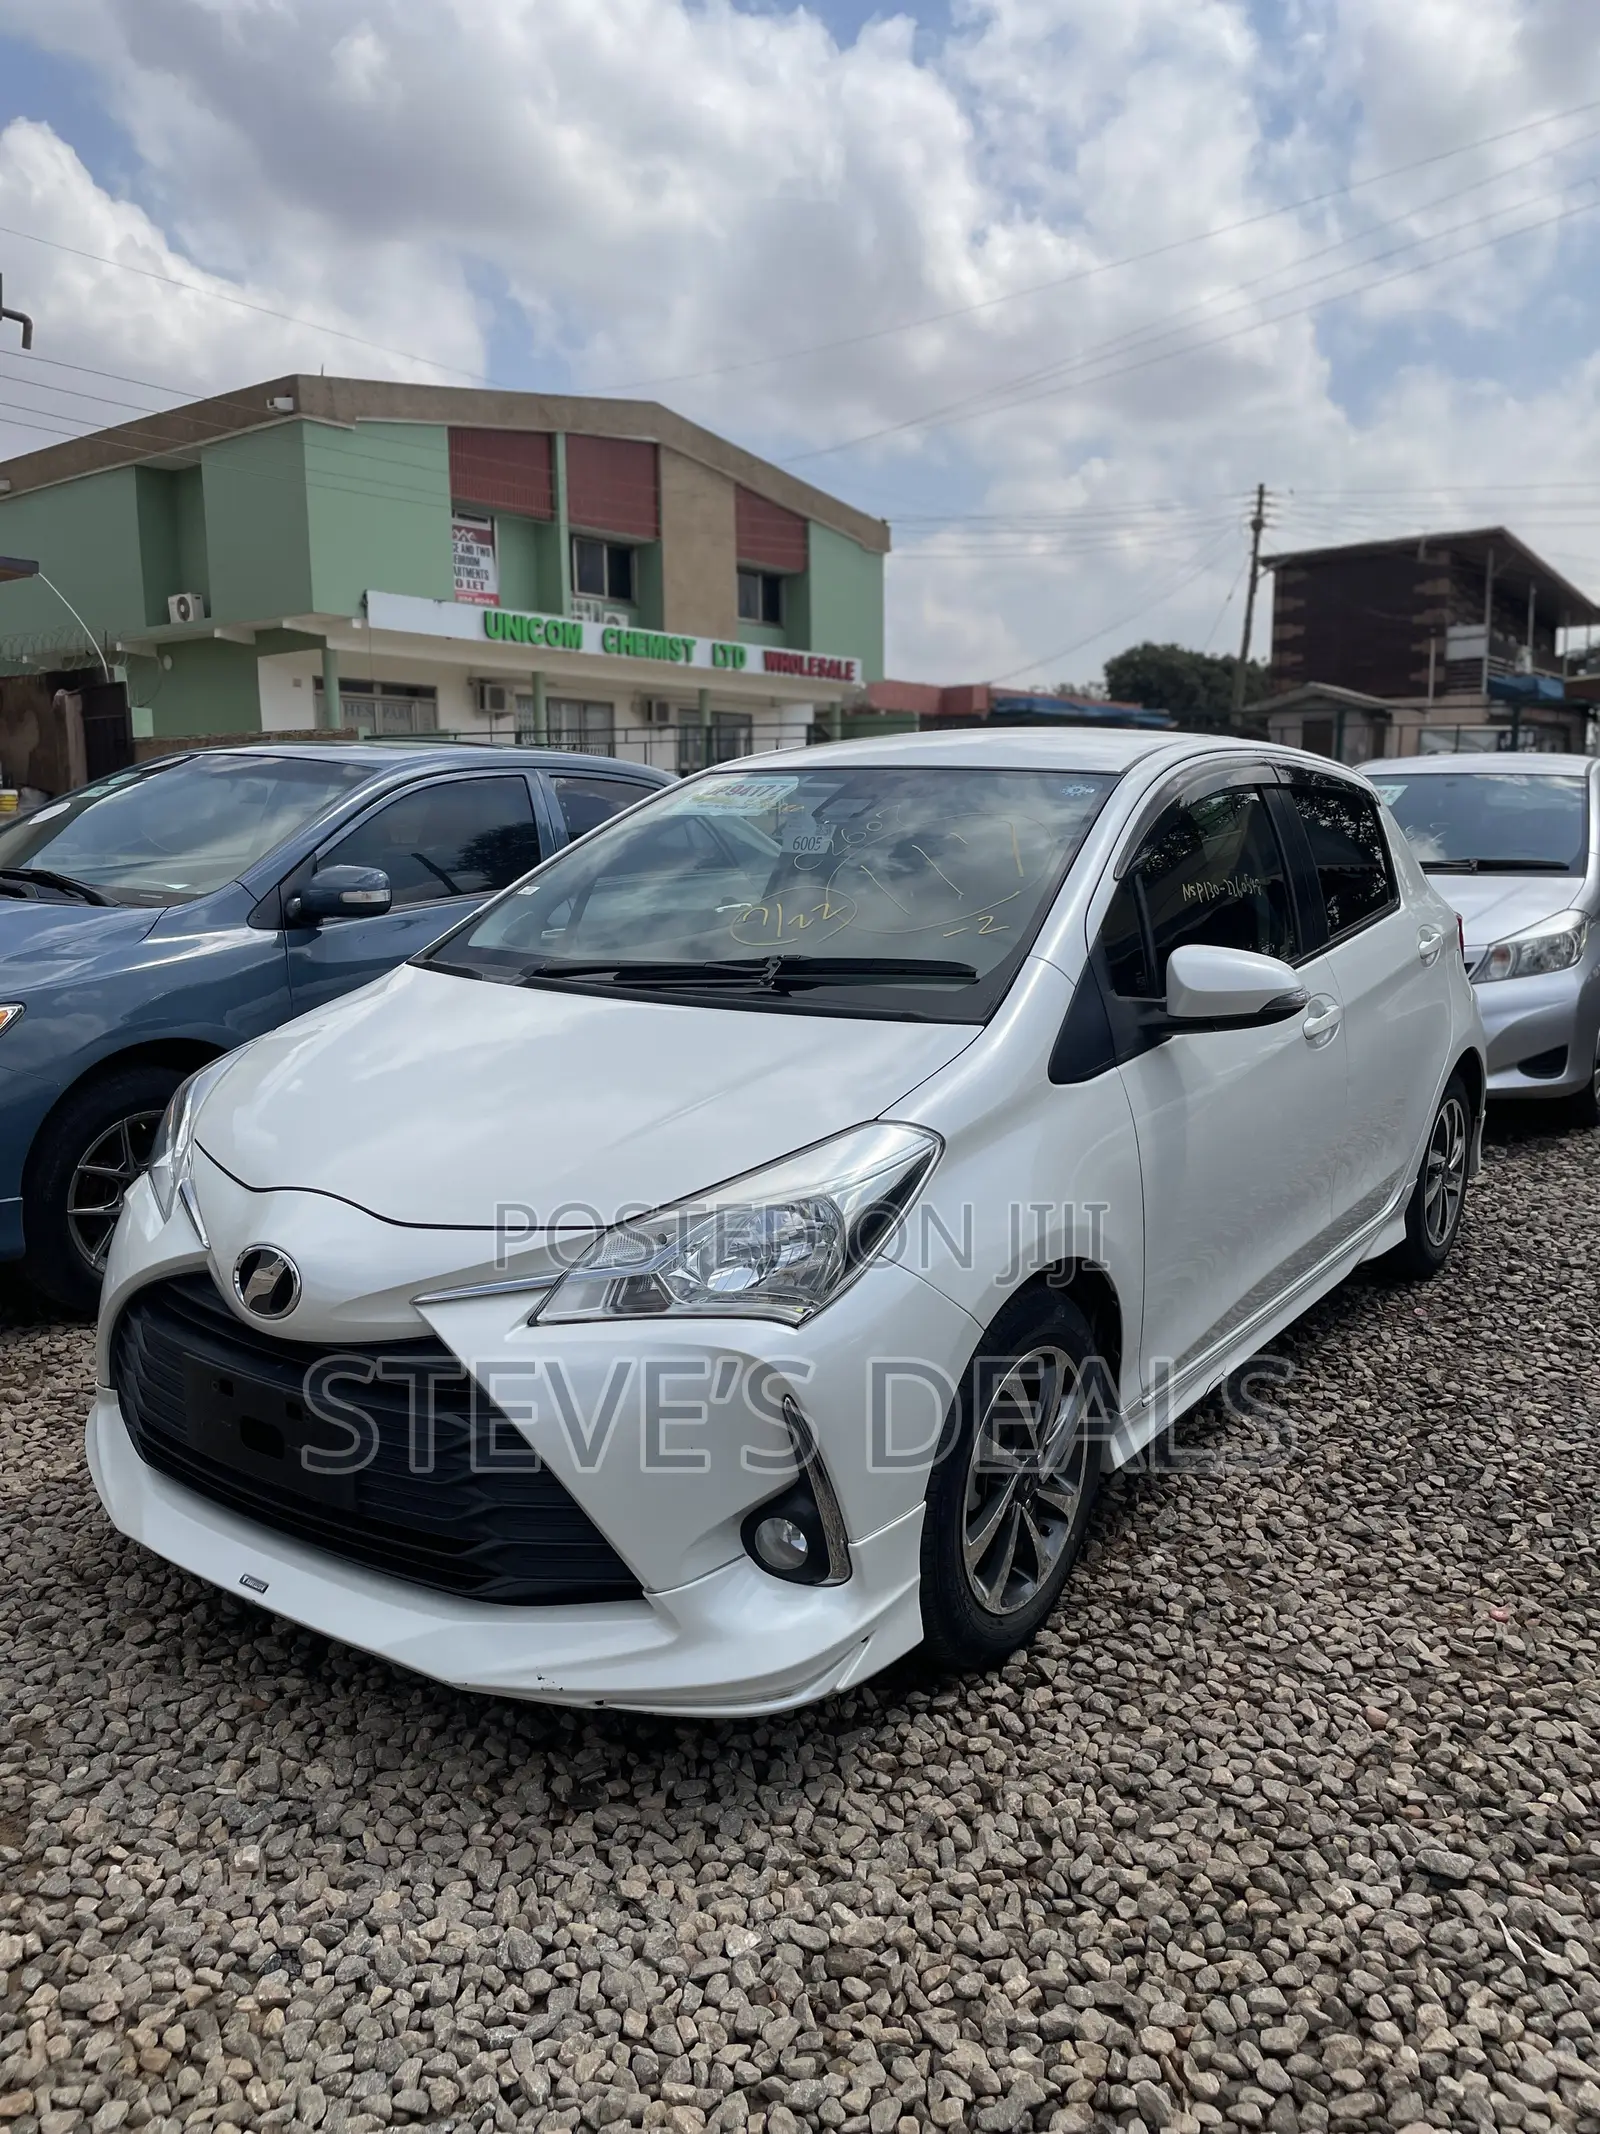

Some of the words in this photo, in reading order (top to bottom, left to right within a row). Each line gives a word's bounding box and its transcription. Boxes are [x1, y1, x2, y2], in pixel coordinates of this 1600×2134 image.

[461, 544, 475, 555] AND
[476, 545, 491, 558] TWO
[466, 579, 485, 591] LET
[483, 610, 583, 650] UNICOM
[601, 627, 696, 662] CHEMIST
[712, 642, 746, 669] LTD
[763, 650, 855, 681] WHOLESALE
[792, 836, 823, 851] 6005
